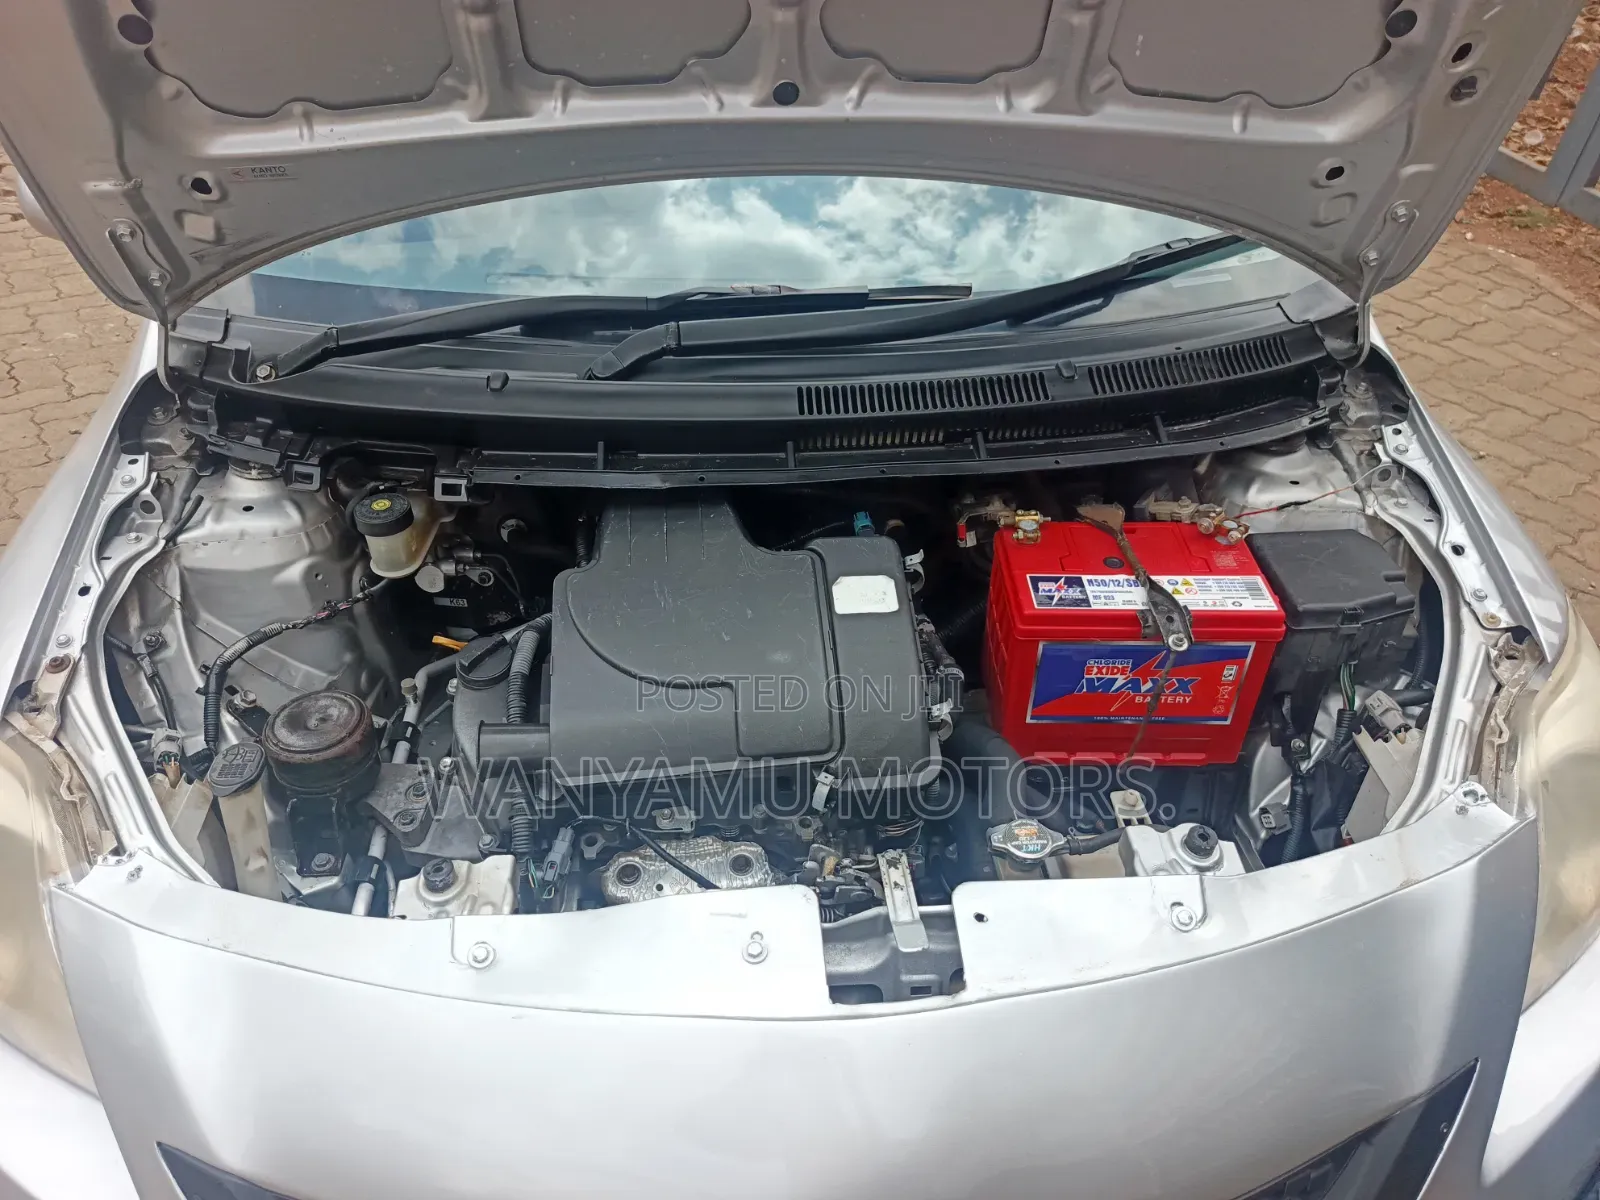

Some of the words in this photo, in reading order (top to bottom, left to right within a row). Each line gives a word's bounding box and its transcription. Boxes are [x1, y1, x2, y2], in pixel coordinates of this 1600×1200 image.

[250, 165, 286, 174] KANTO
[449, 597, 466, 607] K63
[1085, 665, 1131, 676] EXIDE
[1074, 677, 1201, 694] MAXX
[1135, 695, 1193, 704] BATERY
[1021, 843, 1041, 852] HKT
